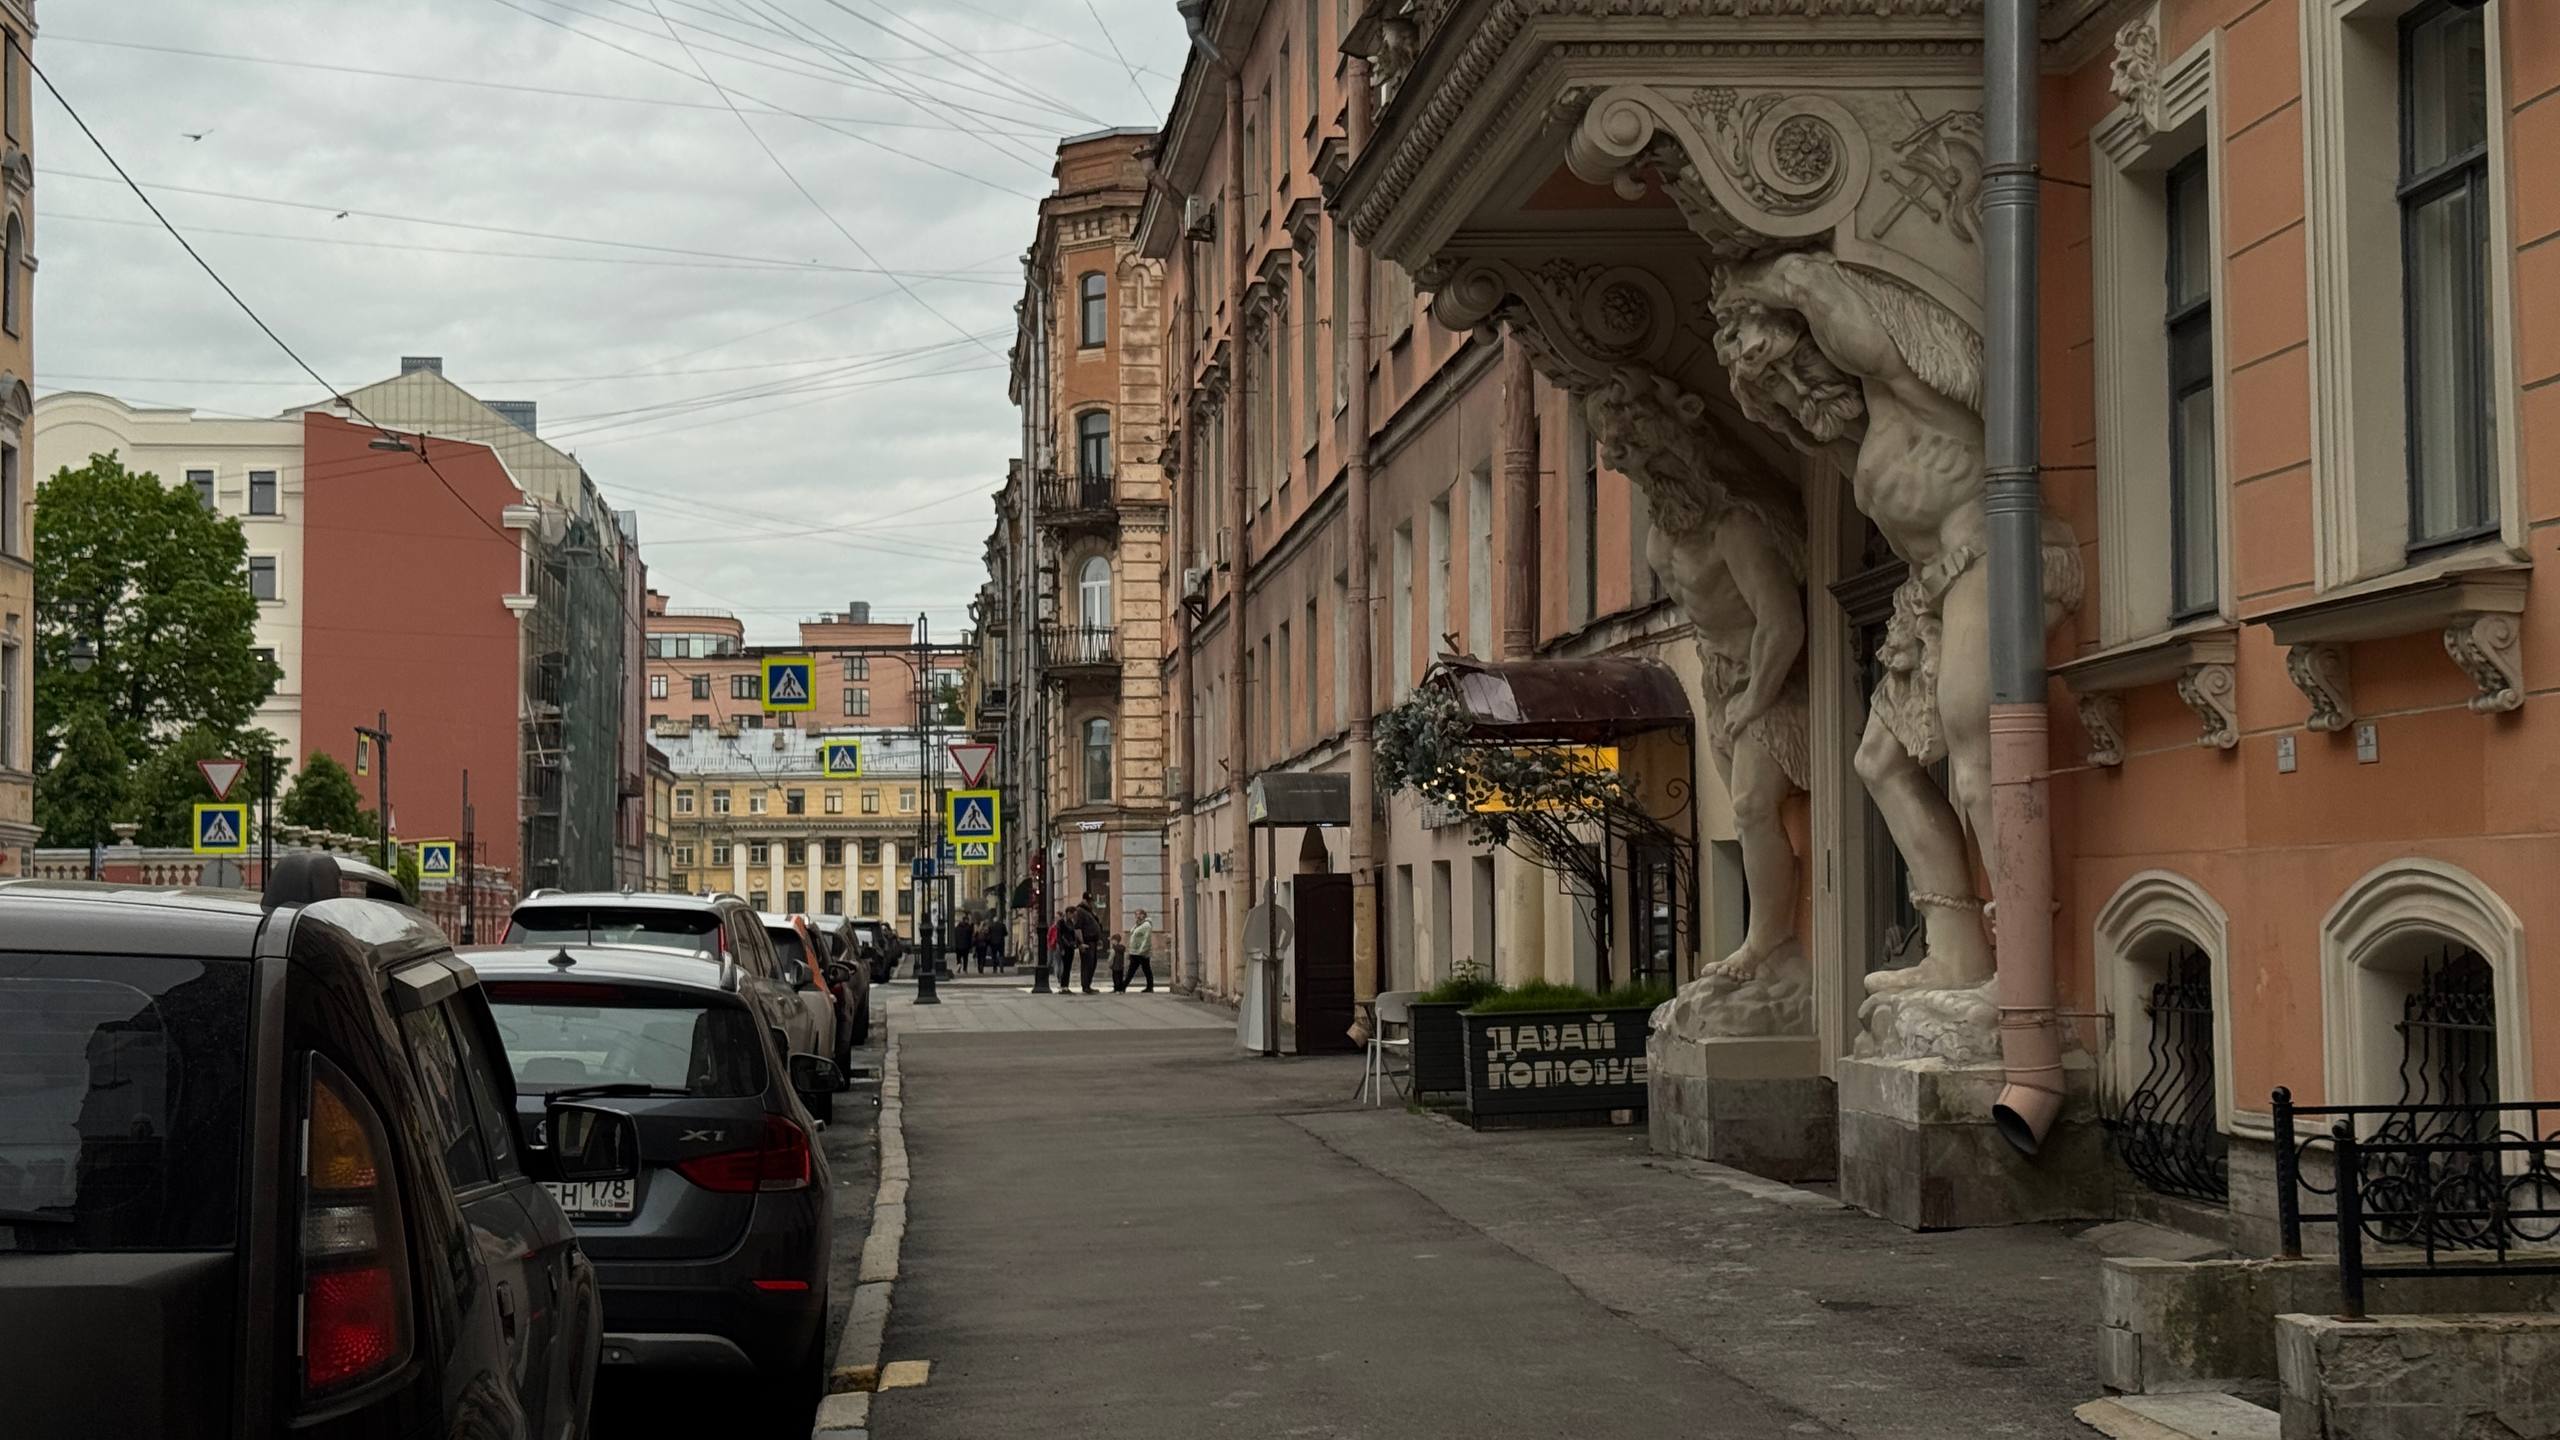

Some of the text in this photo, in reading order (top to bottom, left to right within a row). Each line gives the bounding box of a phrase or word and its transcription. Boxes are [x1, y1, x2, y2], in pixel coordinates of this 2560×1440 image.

[1486, 1014, 1616, 1061] ДАВАЙ
[680, 1129, 726, 1141] X1
[585, 1180, 625, 1199] 178
[592, 1200, 613, 1208] RUS
